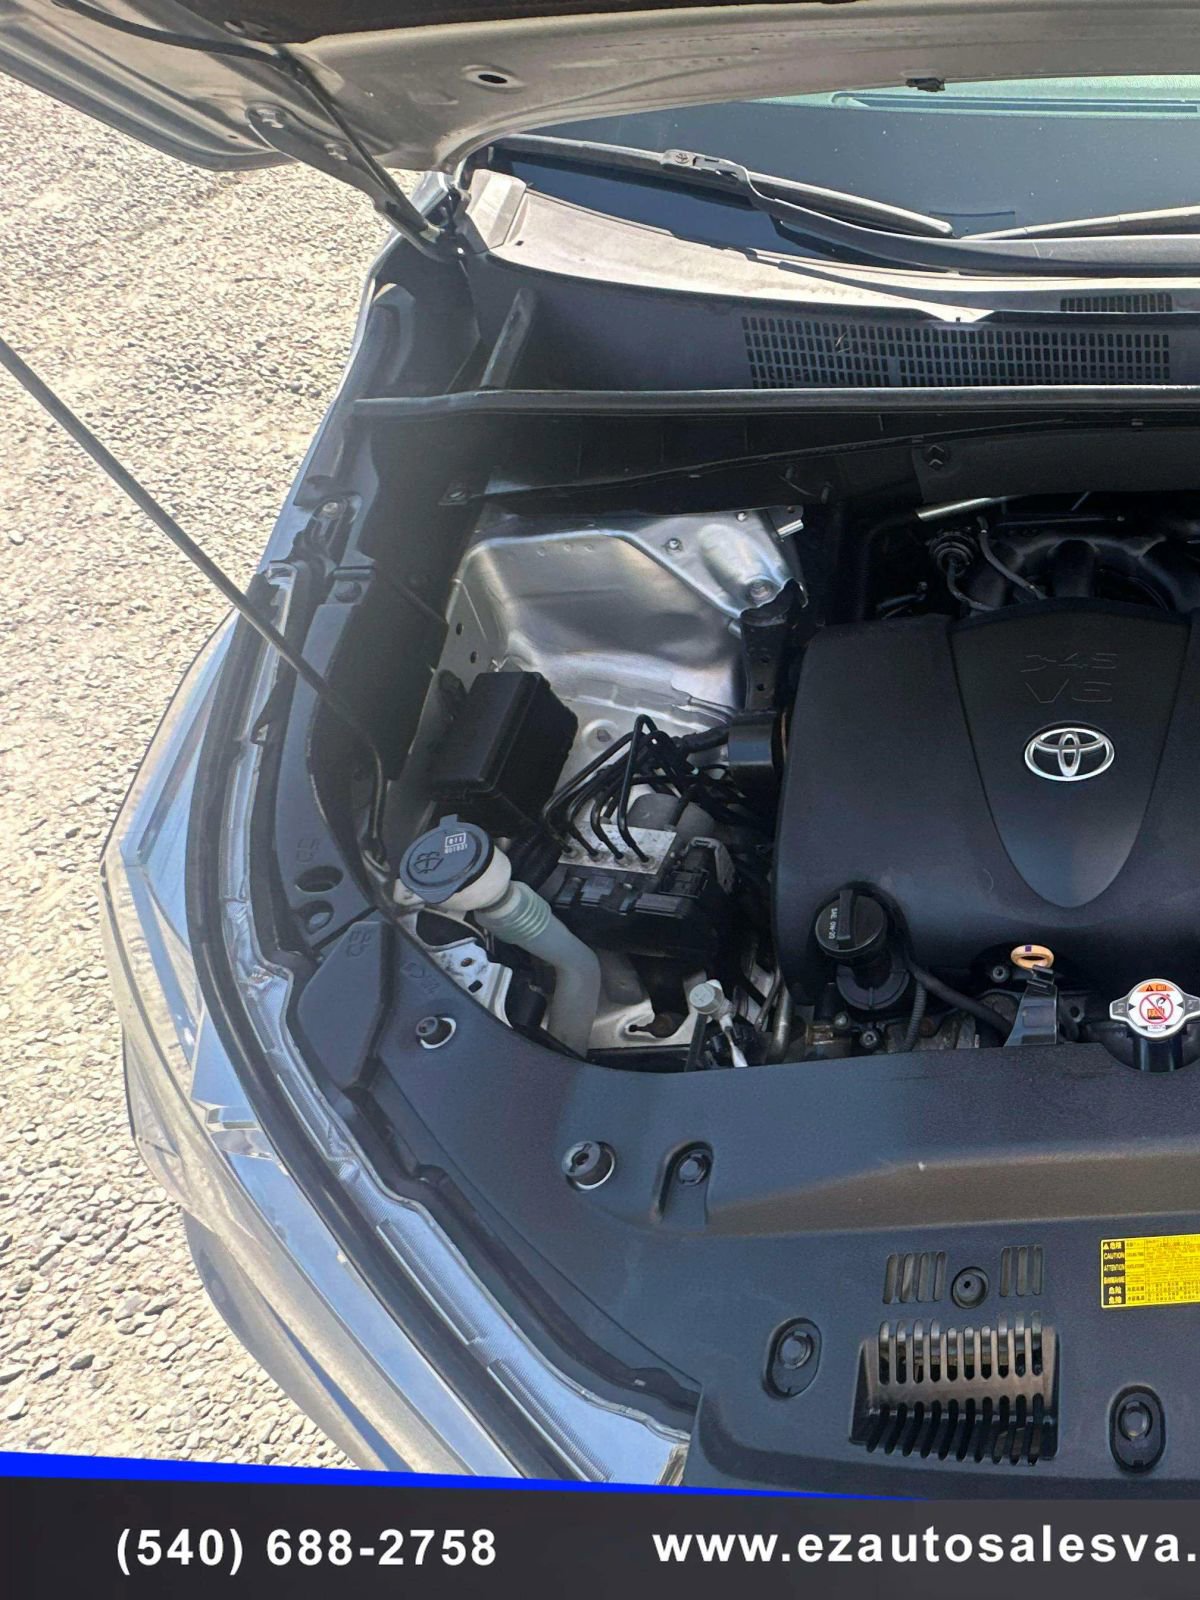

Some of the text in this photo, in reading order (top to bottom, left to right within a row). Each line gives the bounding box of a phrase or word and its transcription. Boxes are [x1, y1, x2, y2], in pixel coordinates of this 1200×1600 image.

[1024, 678, 1113, 703] V6
[1103, 1251, 1125, 1260] CAUTION
[1103, 1263, 1125, 1272] ATTENTION
